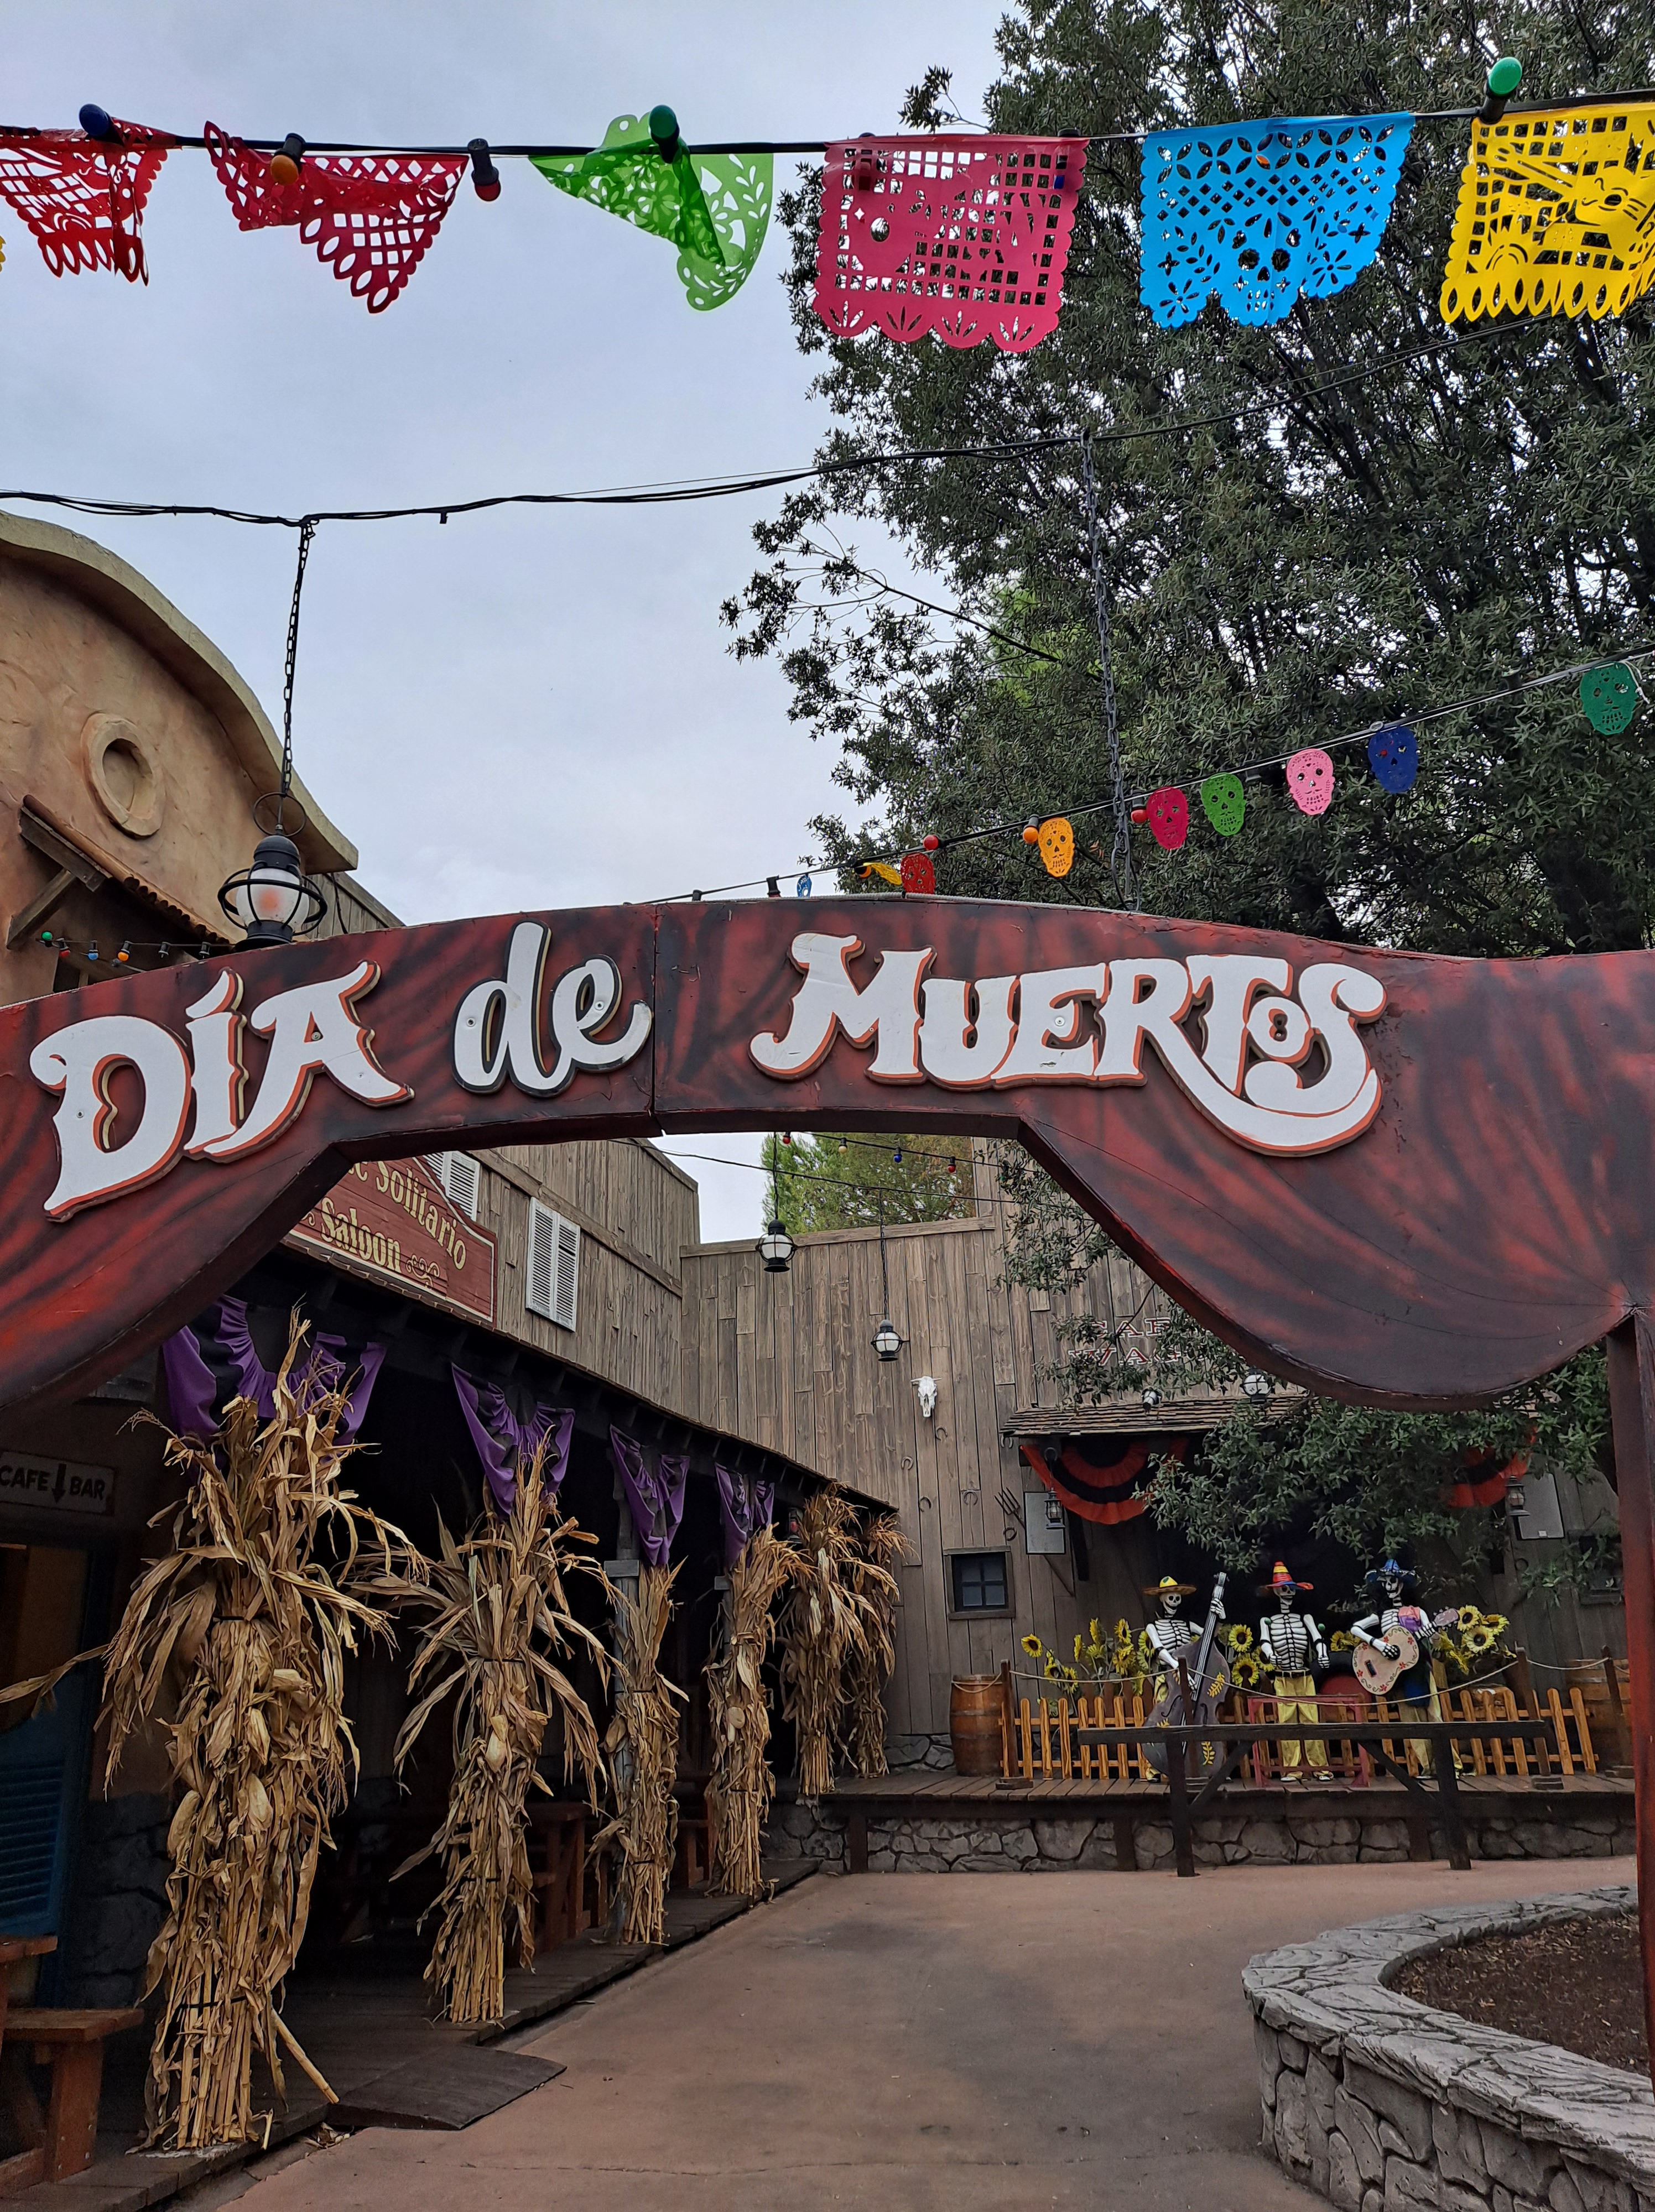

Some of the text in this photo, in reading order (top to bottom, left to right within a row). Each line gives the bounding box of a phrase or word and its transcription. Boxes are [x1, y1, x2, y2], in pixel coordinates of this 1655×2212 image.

[29, 919, 1388, 1221] DÍA de MUERTOS
[320, 1196, 402, 1274] Saloon
[376, 1160, 467, 1271] Solitario
[0, 1465, 106, 1500] CAFE BAR
